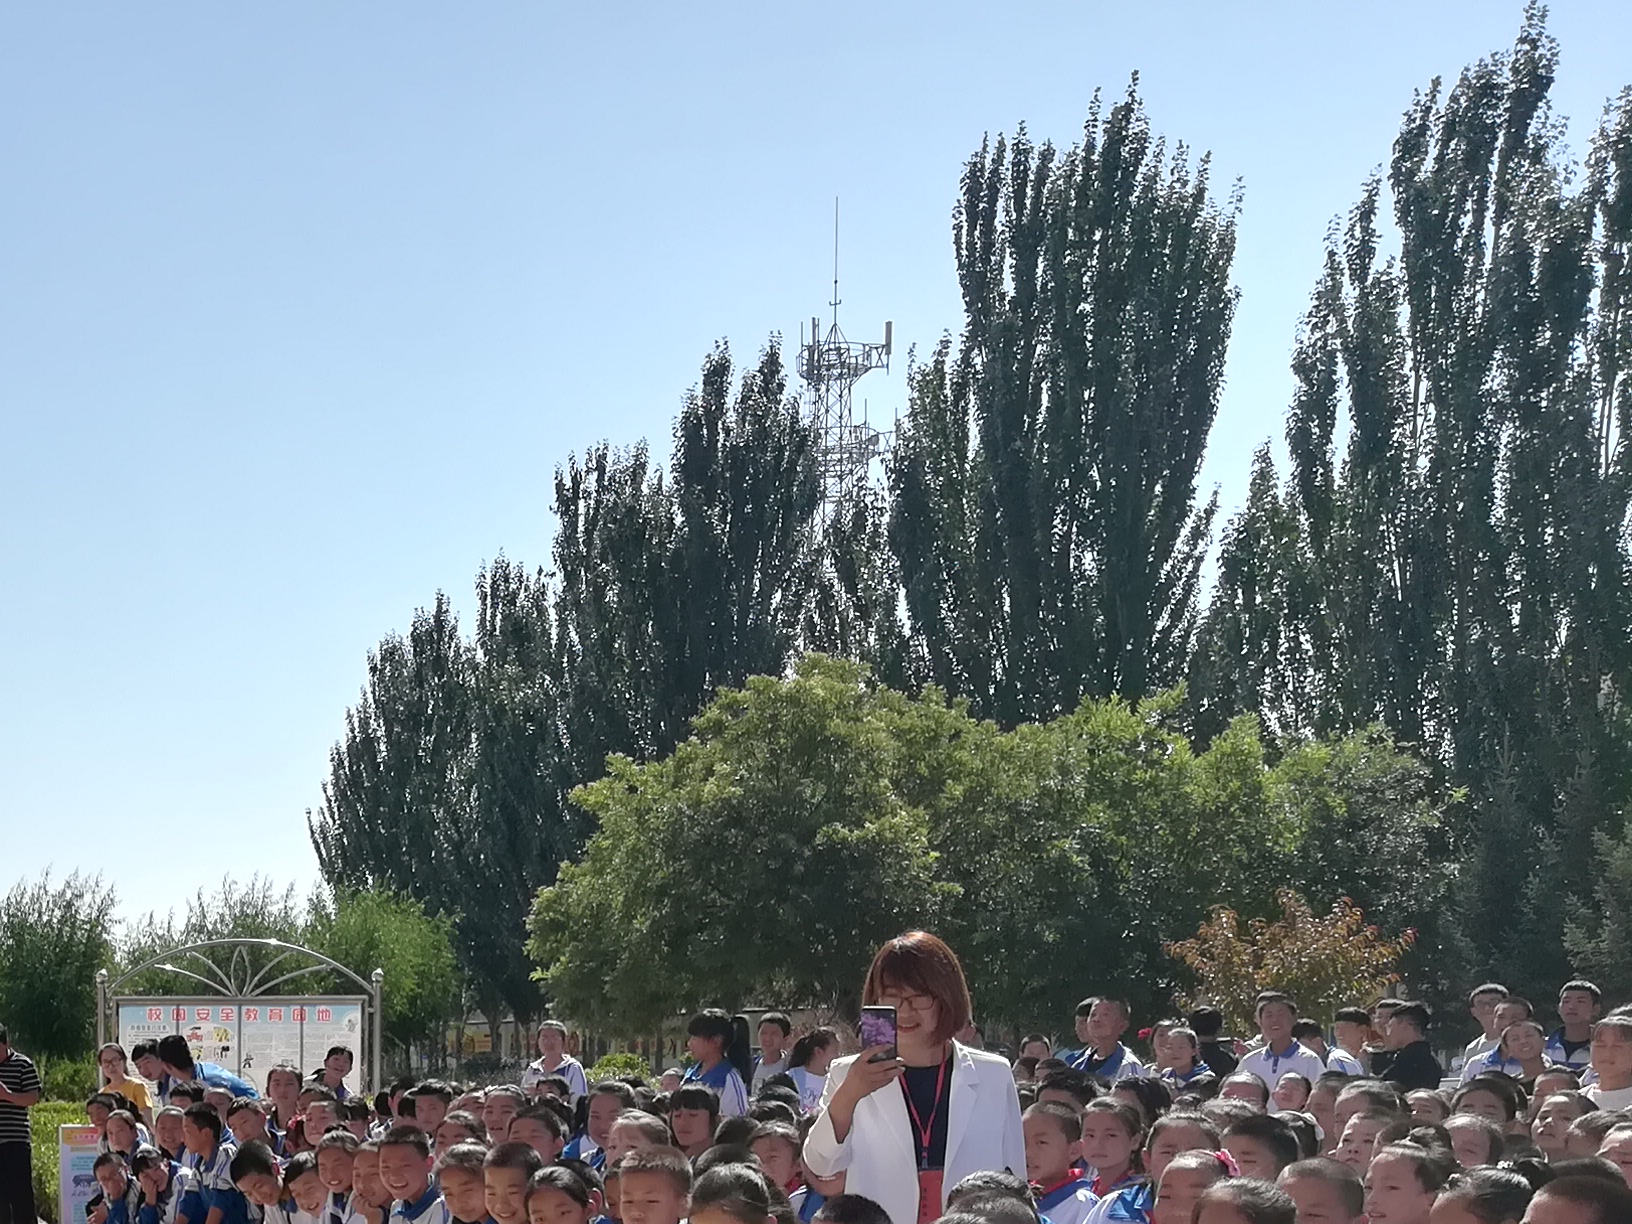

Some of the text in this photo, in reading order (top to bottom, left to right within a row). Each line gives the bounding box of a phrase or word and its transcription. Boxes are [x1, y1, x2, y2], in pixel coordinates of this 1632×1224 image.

[146, 1007, 332, 1023] 校园安全教育园地
